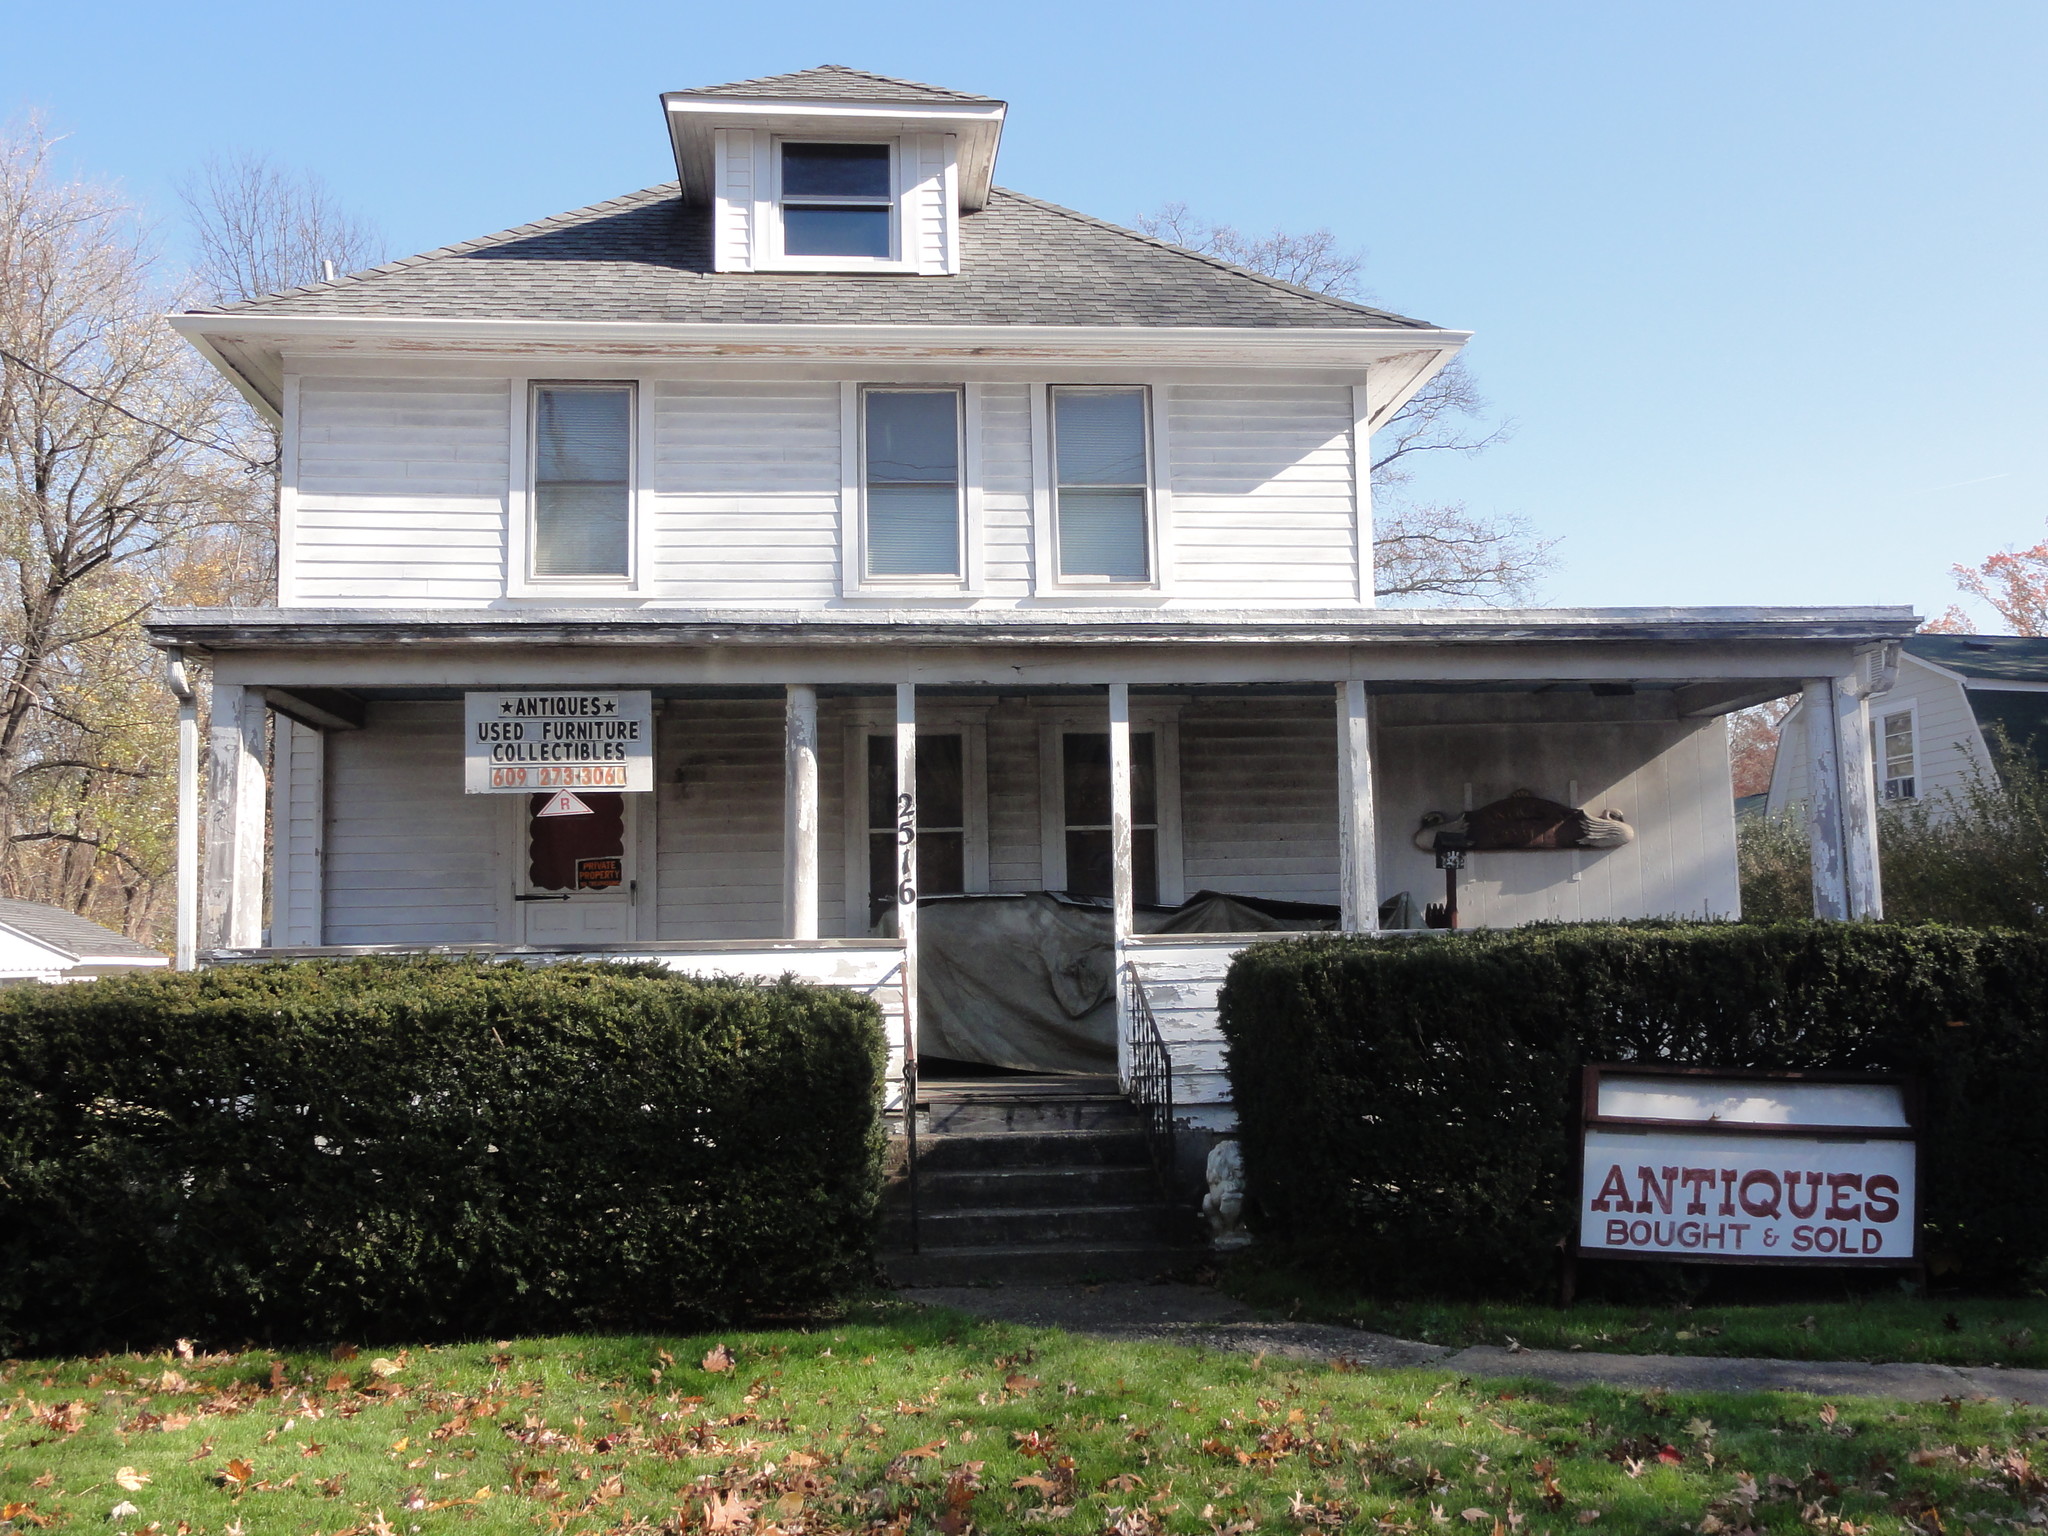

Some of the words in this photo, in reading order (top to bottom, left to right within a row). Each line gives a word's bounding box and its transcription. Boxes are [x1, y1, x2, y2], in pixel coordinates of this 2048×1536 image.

[516, 697, 601, 716] ANTIQUES
[478, 722, 524, 741] USED
[543, 721, 639, 740] FURNITURE
[493, 742, 625, 762] COLLECTIBLES
[493, 767, 527, 786] 609
[560, 797, 570, 810] R
[898, 793, 916, 905] 2516
[579, 870, 620, 879] PROPERTY
[583, 861, 616, 870] PRIVATE
[1591, 1164, 1899, 1223] ANTIQUES
[1606, 1219, 1751, 1250] BOUGHT
[1763, 1227, 1780, 1248] &
[1791, 1225, 1883, 1254] SOLD
